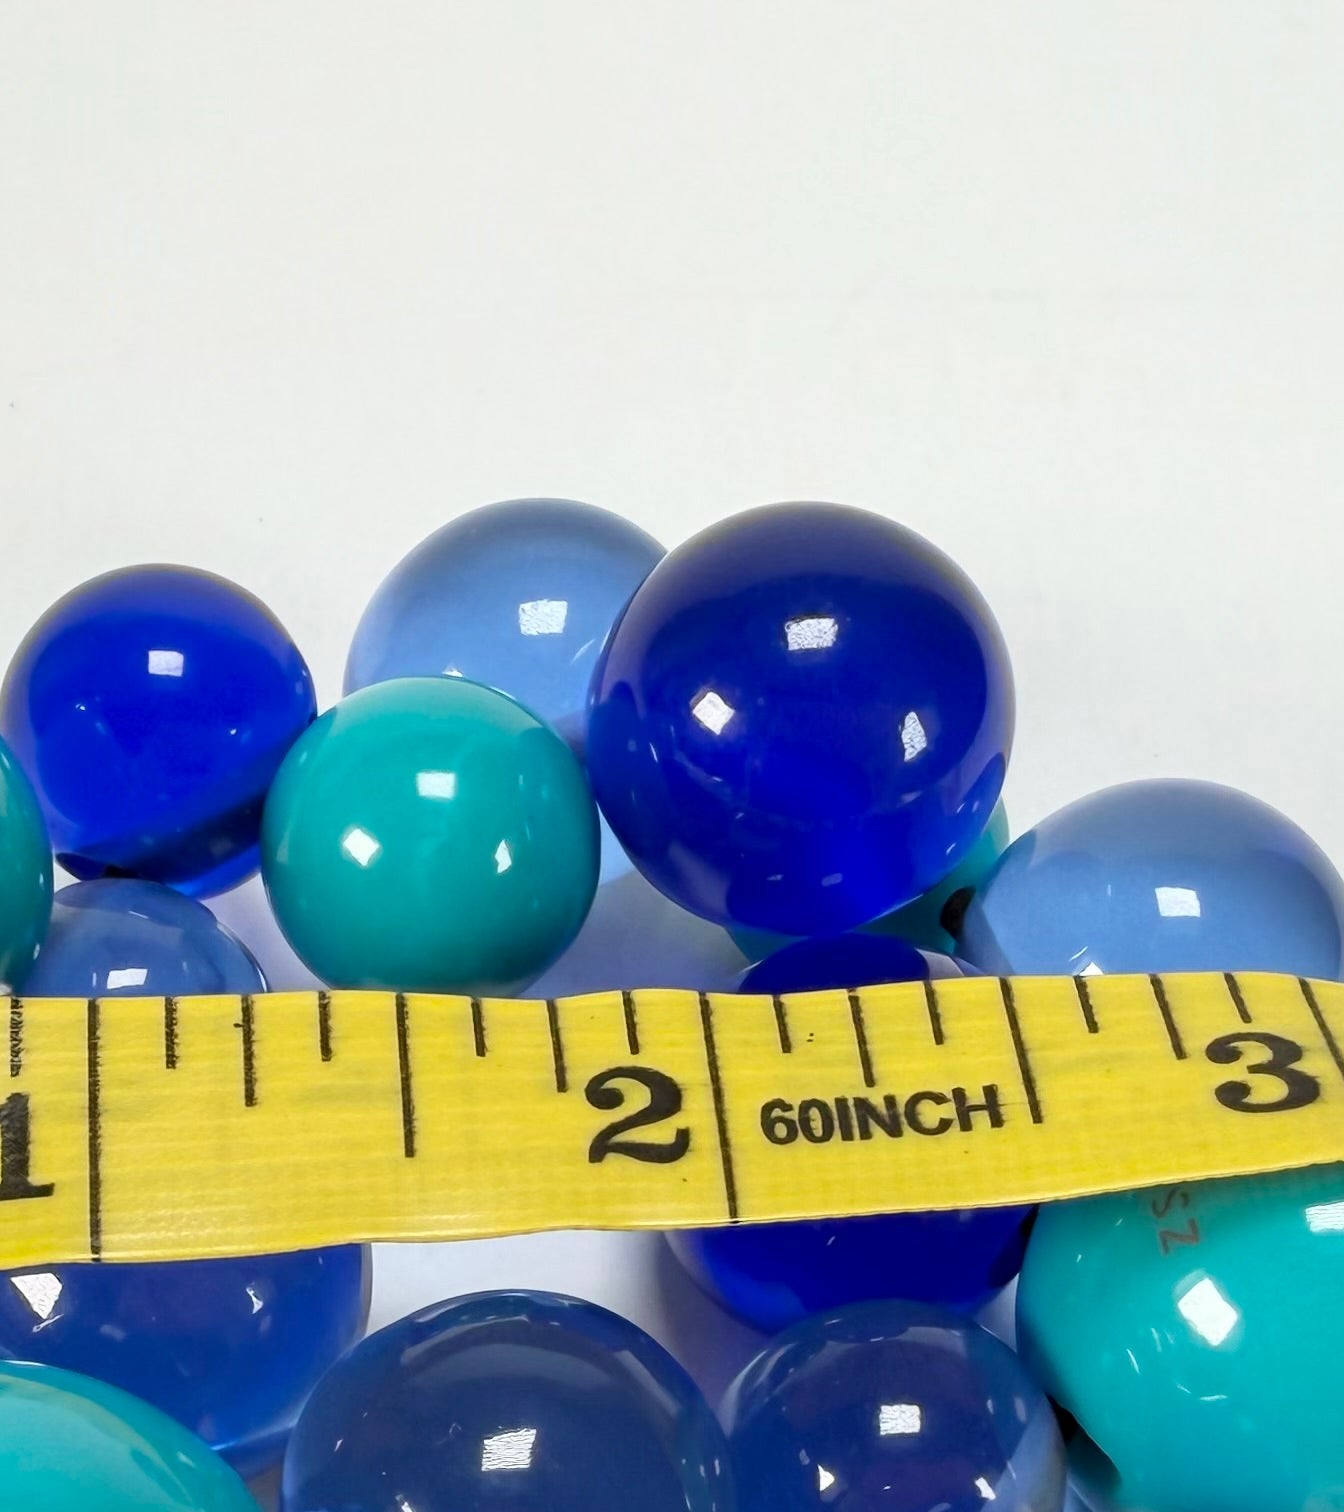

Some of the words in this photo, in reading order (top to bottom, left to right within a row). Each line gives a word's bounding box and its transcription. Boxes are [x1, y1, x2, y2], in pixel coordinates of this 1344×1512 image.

[584, 1066, 690, 1163] 2
[760, 1084, 1005, 1145] 60INCH
[1205, 1031, 1320, 1113] 3
